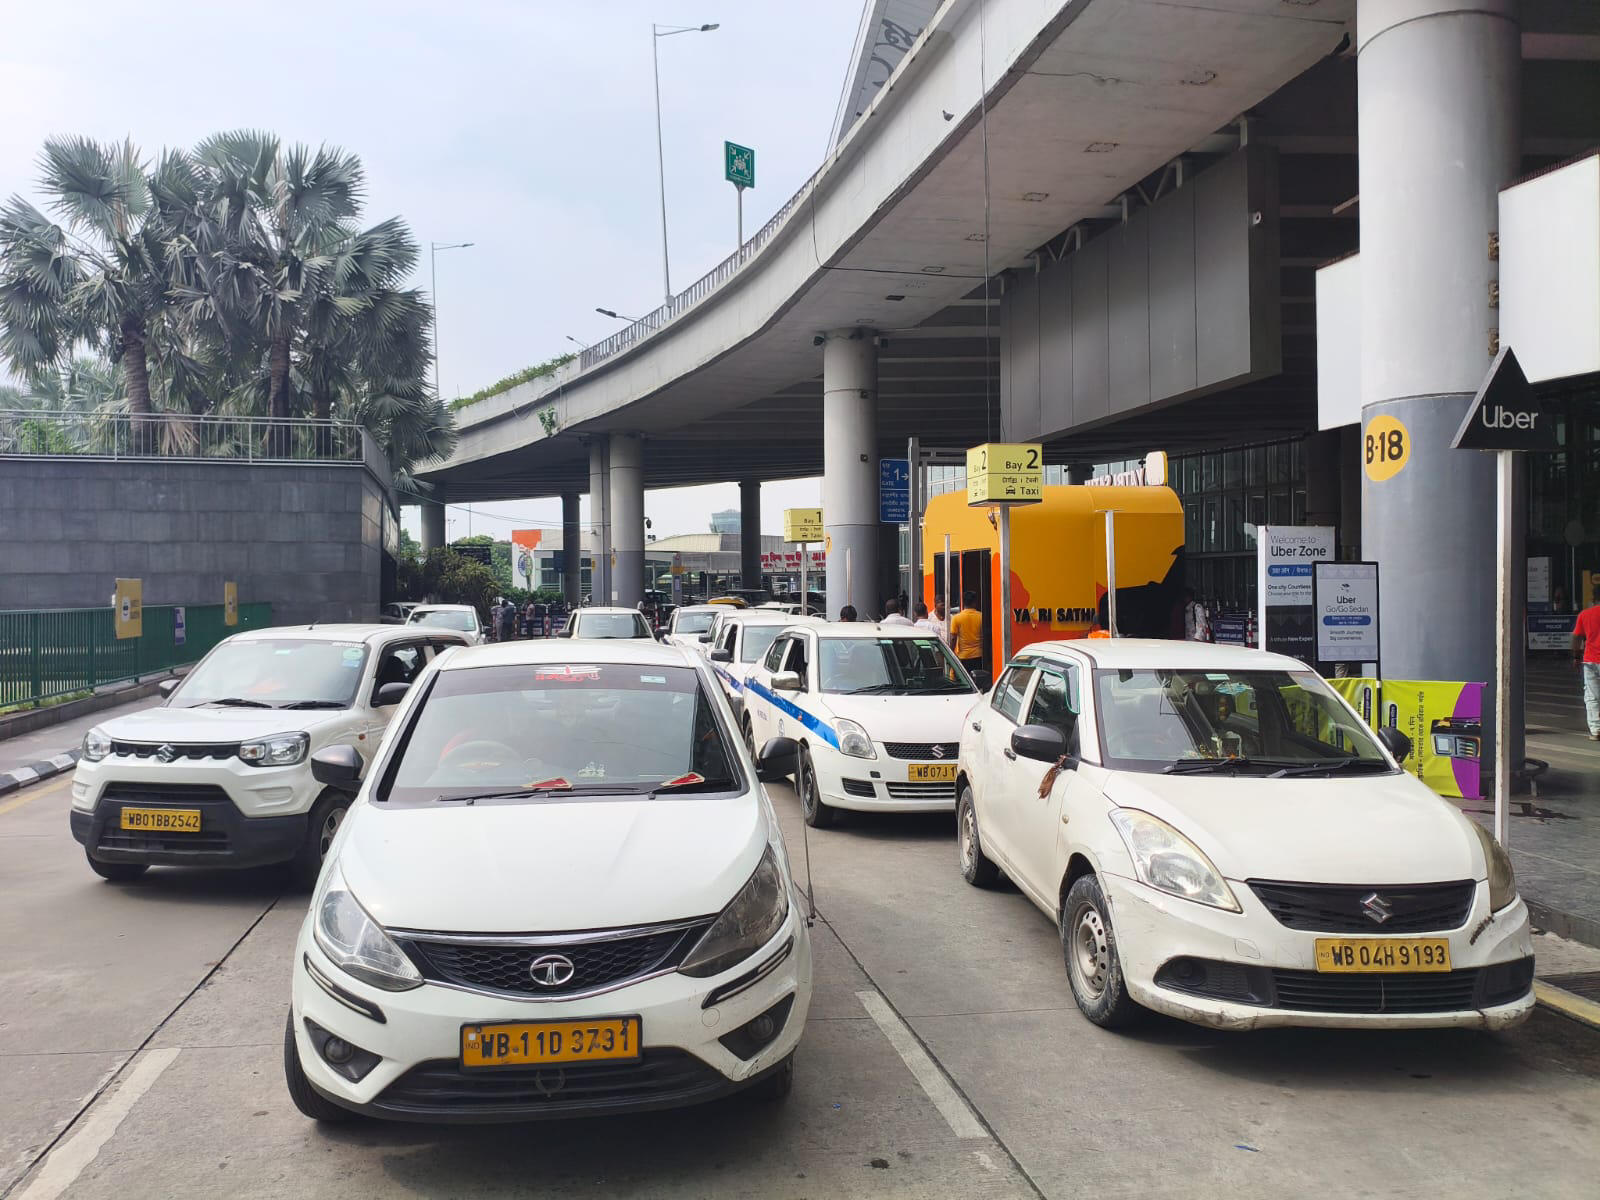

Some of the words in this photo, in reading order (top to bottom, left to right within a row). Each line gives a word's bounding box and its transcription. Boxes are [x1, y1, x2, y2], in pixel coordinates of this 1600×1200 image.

[1482, 405, 1539, 429] Uber
[981, 450, 987, 470] 2
[1005, 461, 1023, 471] Bay
[1026, 449, 1039, 469] 2
[893, 468, 900, 481] 1
[1020, 486, 1039, 495] Taxi
[816, 511, 822, 523] 1
[1271, 536, 1308, 544] Welcome
[1271, 545, 1297, 557] Uber
[1299, 545, 1327, 557] Zone
[1336, 595, 1356, 604] Uber
[1014, 607, 1052, 622] YARI
[1349, 605, 1369, 613] Sedan
[128, 813, 199, 828] WB01BB2542
[1331, 945, 1355, 966] WB
[1359, 945, 1395, 966] 04H
[1399, 945, 1445, 966] 9193
[571, 1023, 629, 1053] 3731
